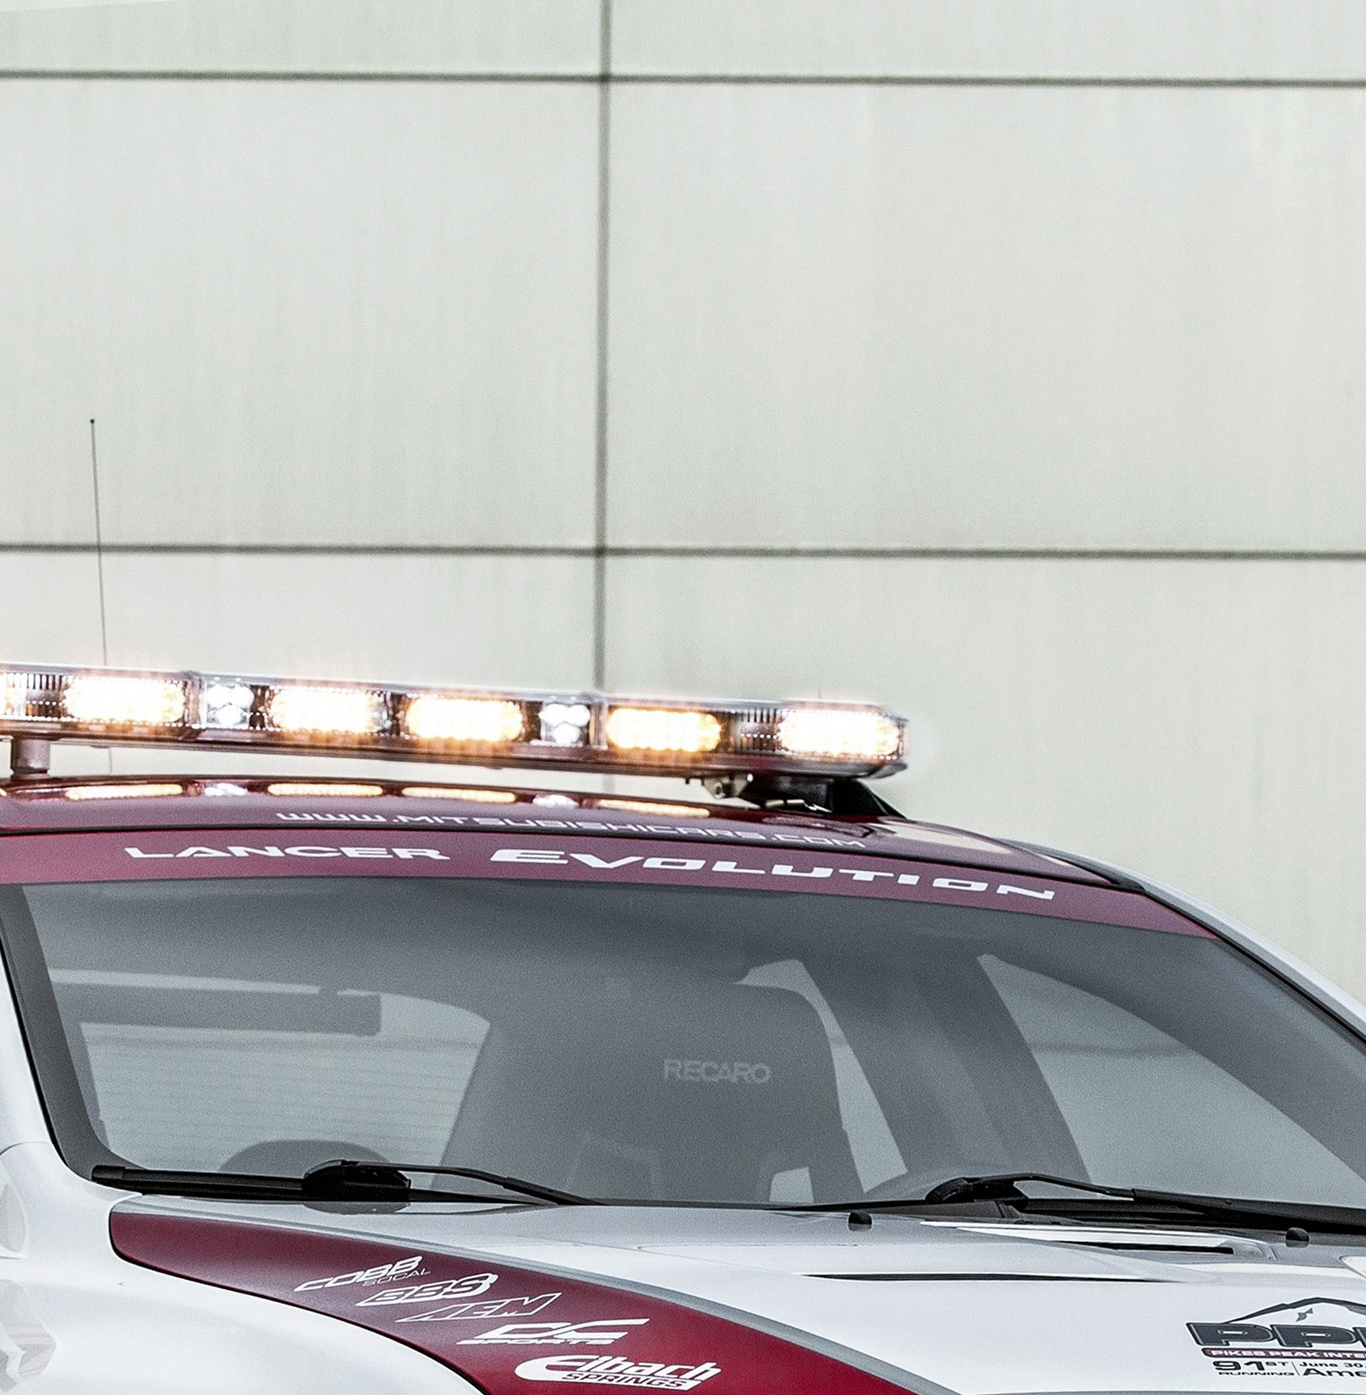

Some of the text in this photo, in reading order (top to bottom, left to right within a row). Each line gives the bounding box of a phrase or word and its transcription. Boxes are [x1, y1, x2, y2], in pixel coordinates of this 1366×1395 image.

[123, 846, 1056, 900] LANCER EVOLUTION
[663, 1059, 771, 1083] RECARO
[293, 1256, 423, 1292] COBB
[362, 1268, 431, 1287] SOCAL
[1210, 1350, 1265, 1358] PIKES
[1268, 1351, 1320, 1359] PEAK
[514, 1354, 723, 1381] Eibach
[562, 1372, 687, 1388] SPRINGS
